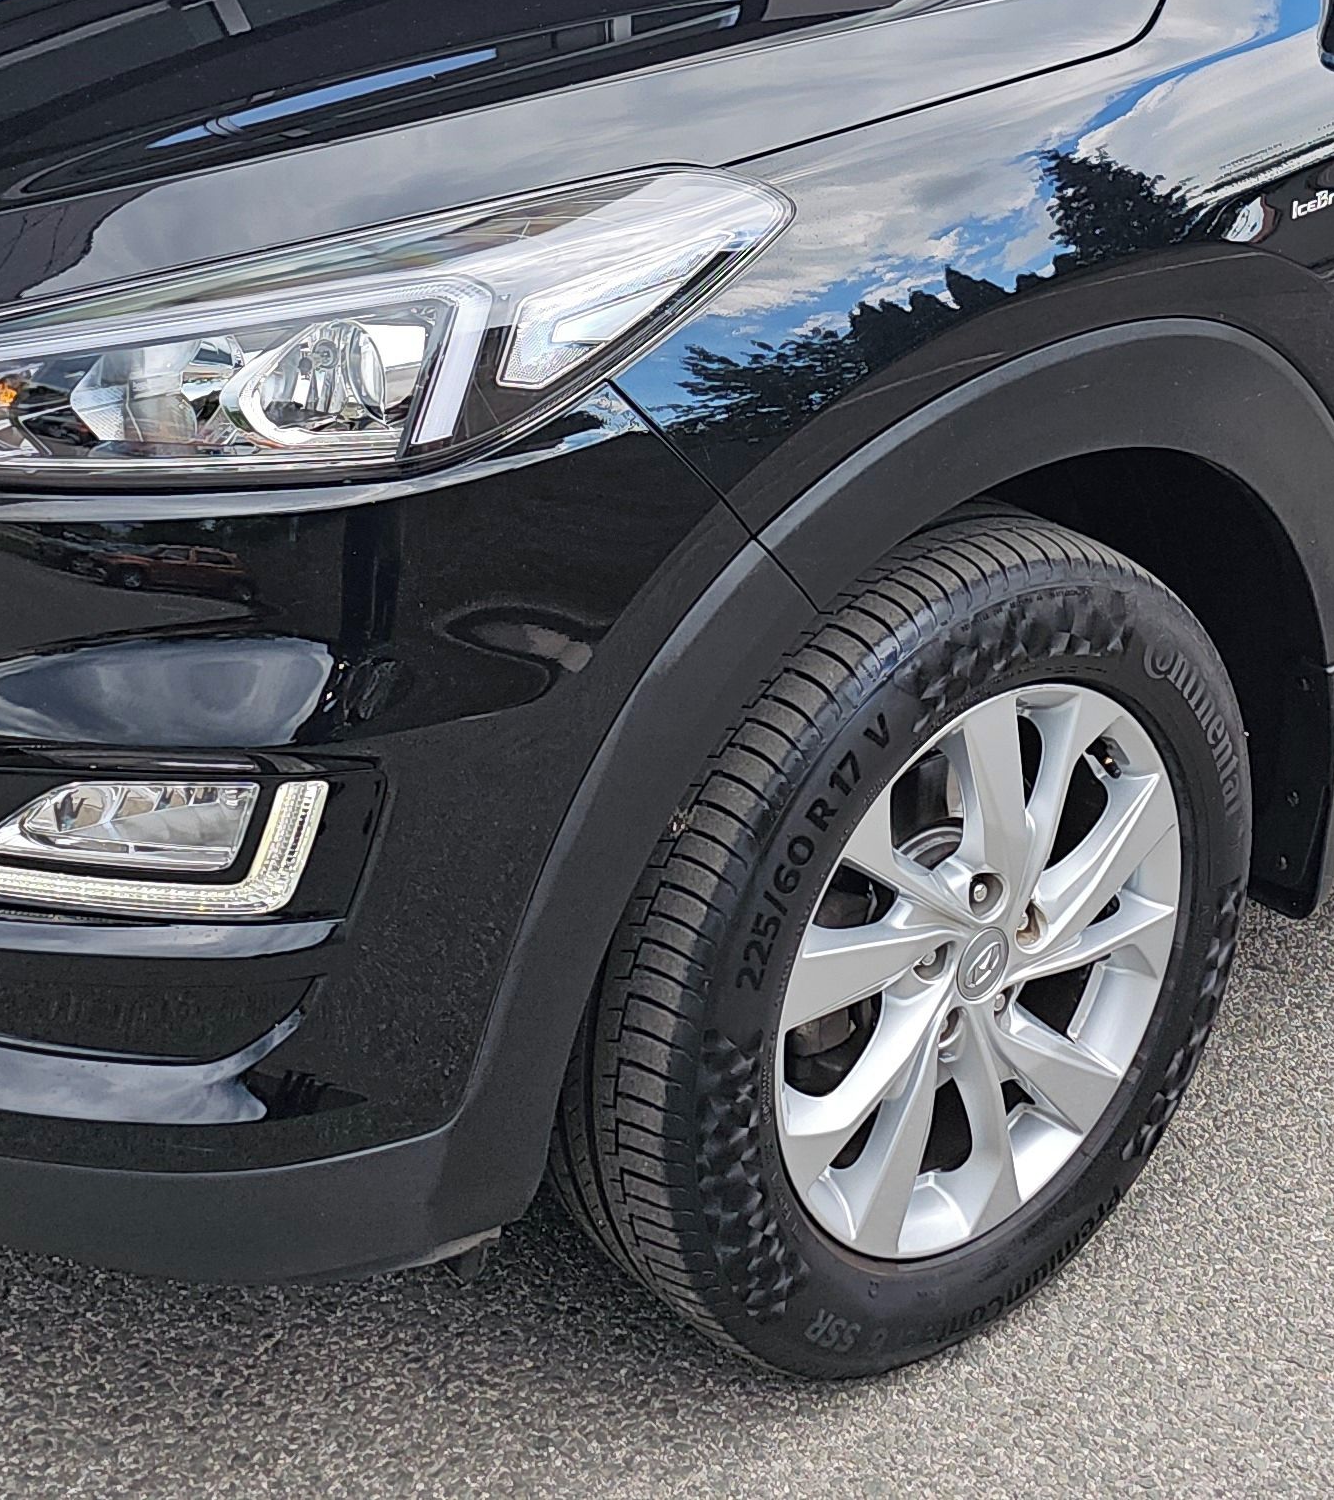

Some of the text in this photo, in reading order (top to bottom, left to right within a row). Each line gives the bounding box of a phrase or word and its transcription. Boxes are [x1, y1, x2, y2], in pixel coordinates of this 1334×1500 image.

[735, 832, 816, 991] 225/60
[863, 712, 890, 749] V
[803, 1307, 863, 1353] SSR
